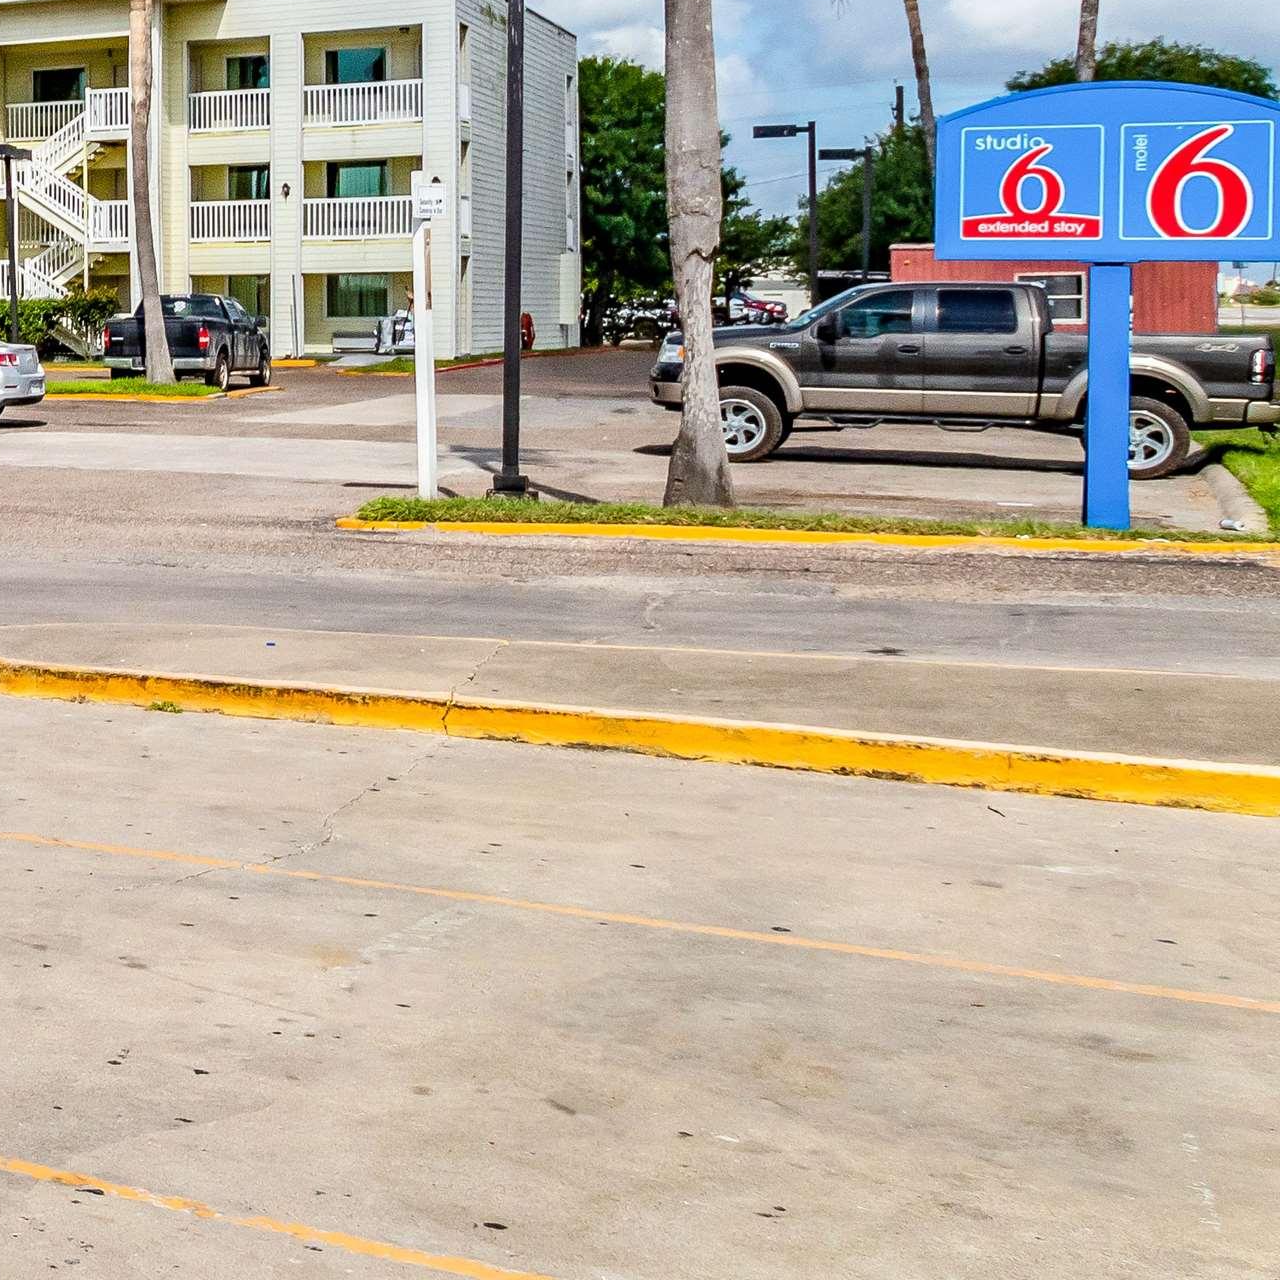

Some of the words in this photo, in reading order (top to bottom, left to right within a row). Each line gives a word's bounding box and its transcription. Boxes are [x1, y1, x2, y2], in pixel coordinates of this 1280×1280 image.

[975, 133, 1045, 151] studio
[1133, 133, 1148, 171] motel
[999, 144, 1066, 216] 6
[1146, 124, 1254, 239] 6
[977, 220, 1049, 234] extended
[1053, 220, 1086, 236] stay
